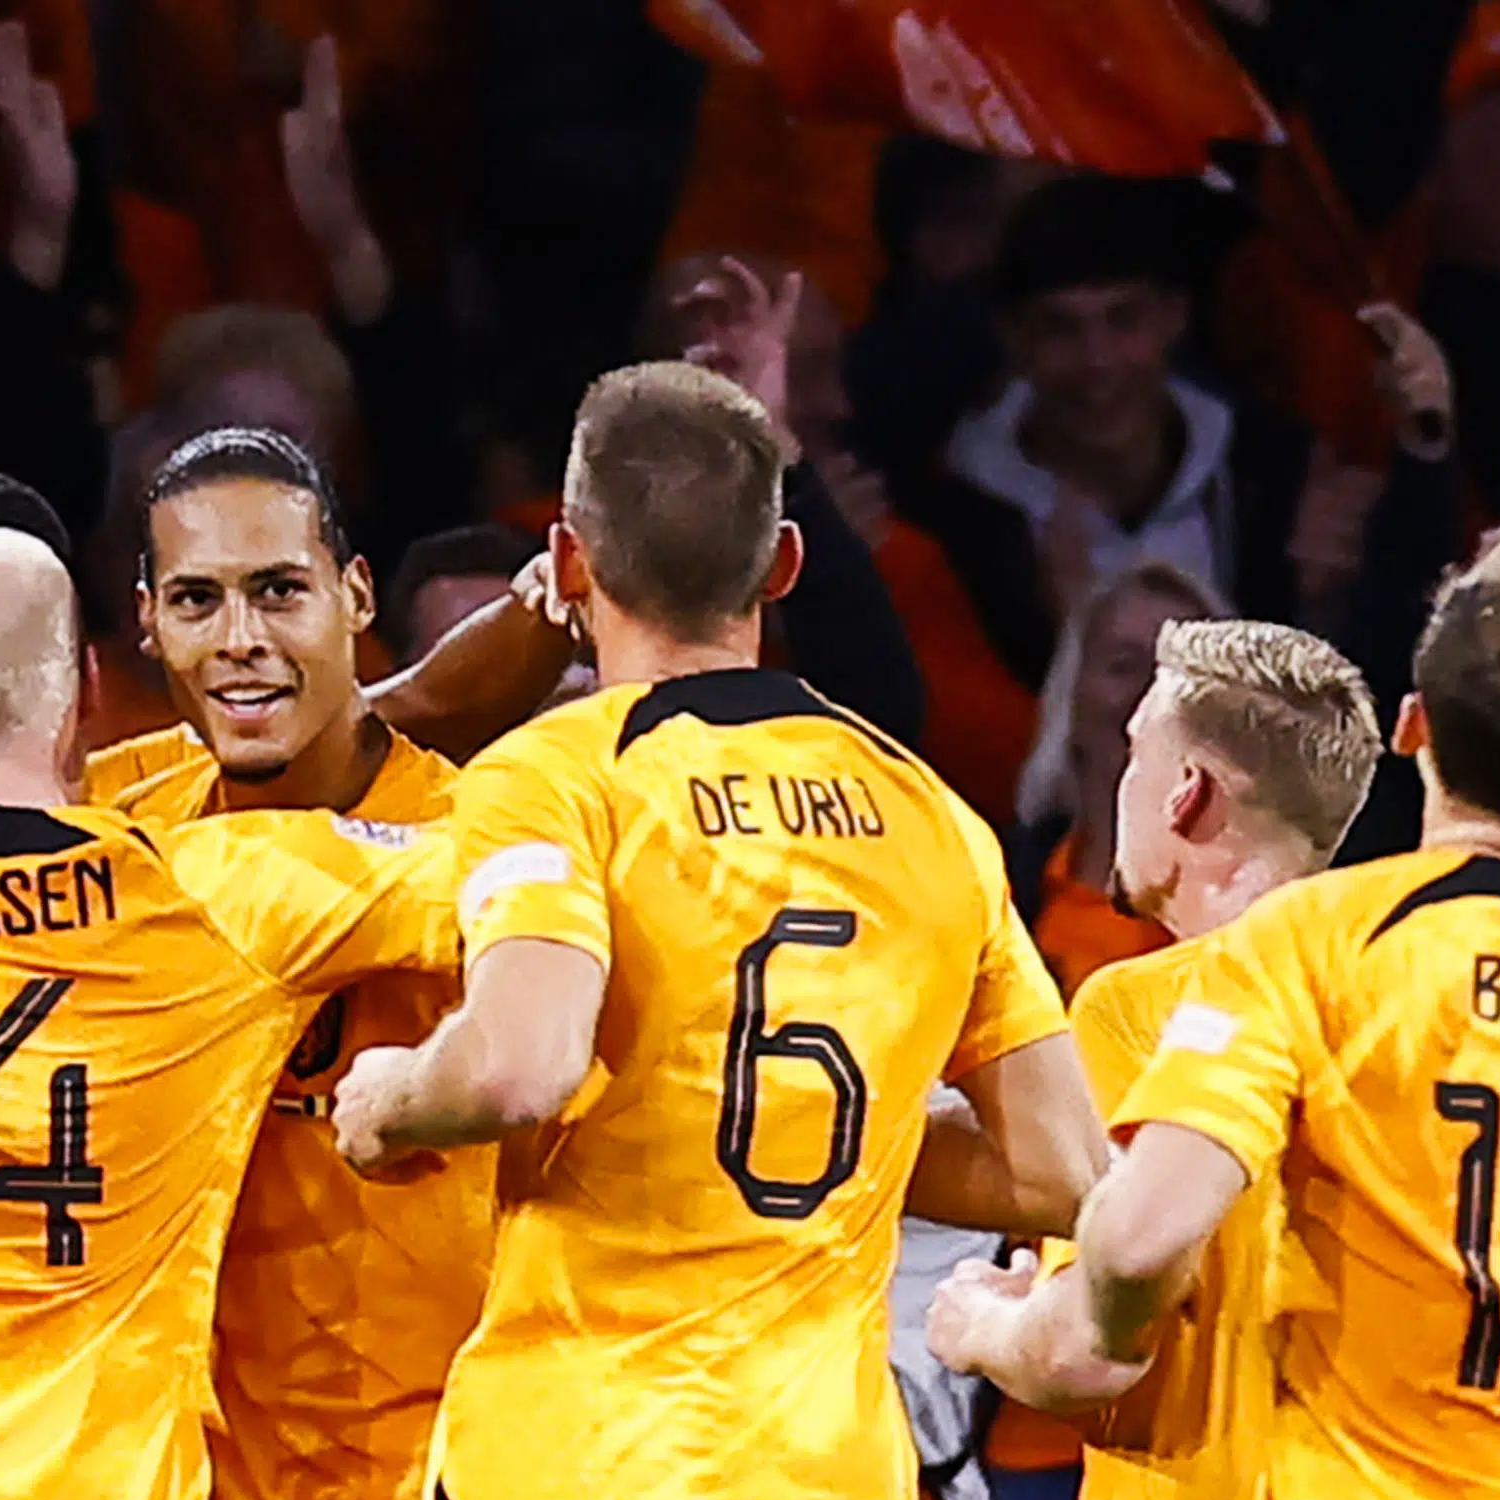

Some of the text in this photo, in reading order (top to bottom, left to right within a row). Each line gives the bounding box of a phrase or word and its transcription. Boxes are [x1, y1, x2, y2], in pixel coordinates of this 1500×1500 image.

[689, 773, 886, 838] DE VRIJ
[717, 908, 866, 1217] 6
